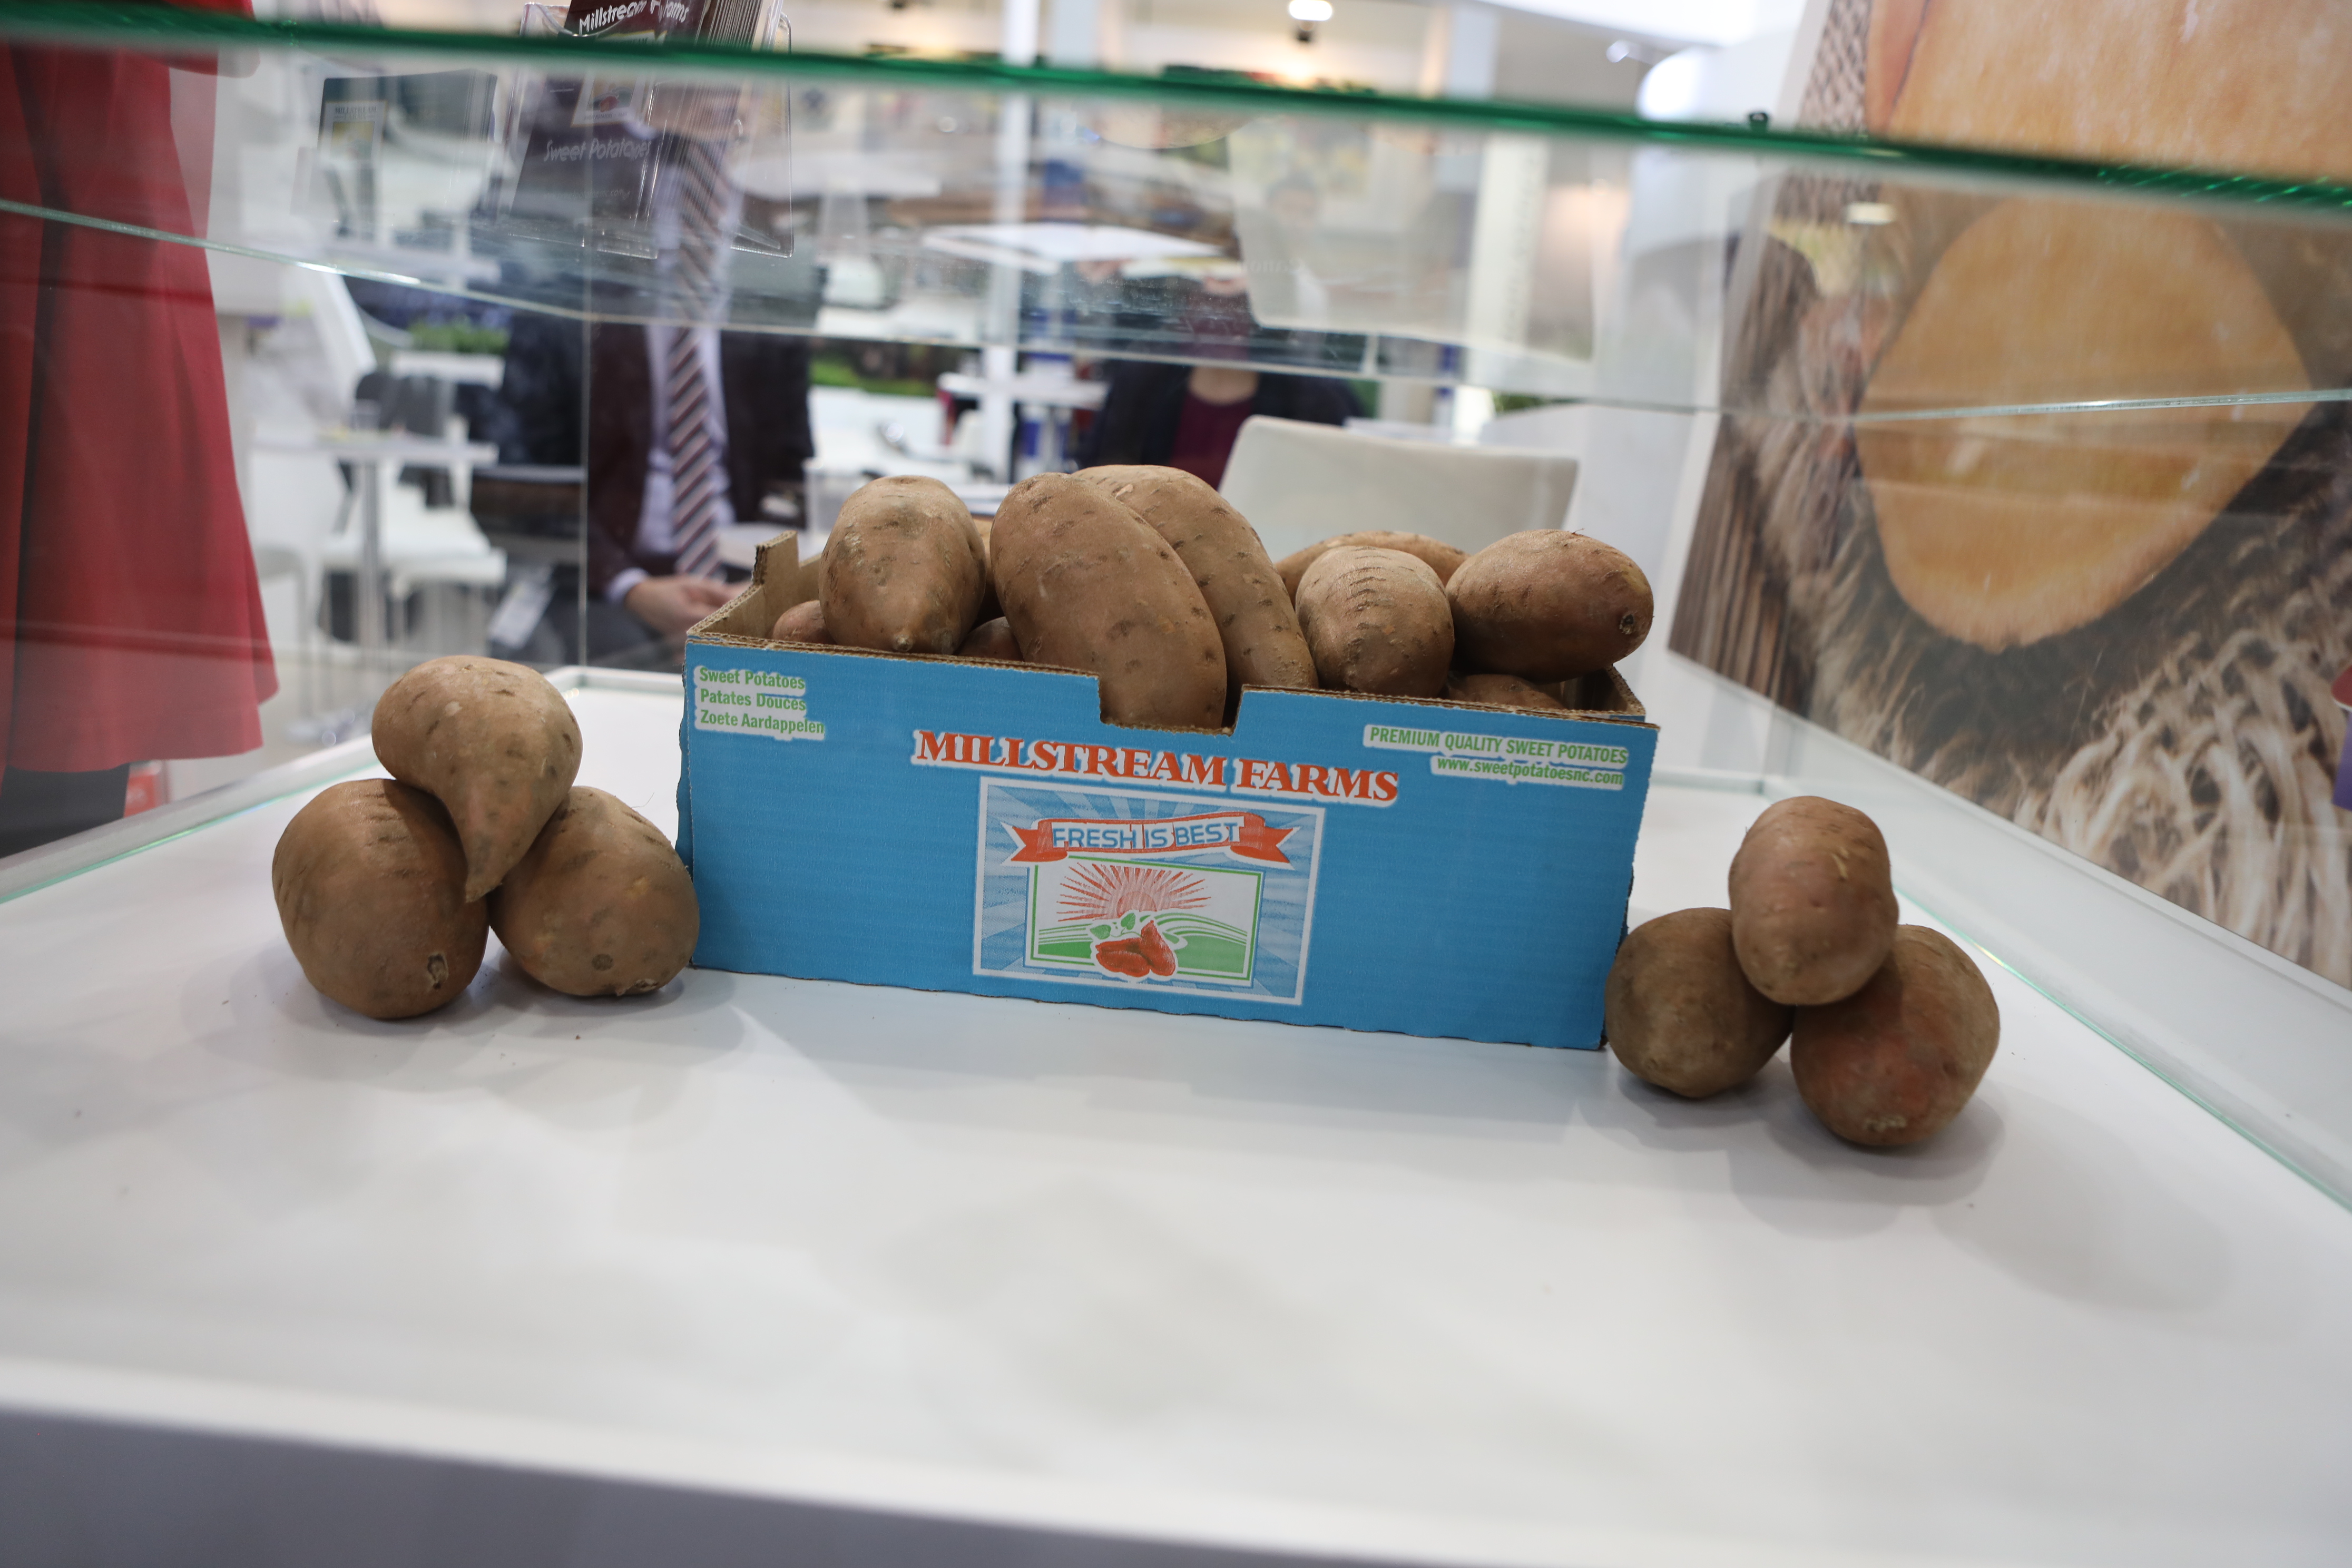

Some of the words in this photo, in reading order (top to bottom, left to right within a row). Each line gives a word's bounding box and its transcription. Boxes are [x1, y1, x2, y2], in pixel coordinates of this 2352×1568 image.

[580, 0, 647, 35] Millstream
[544, 139, 586, 162] Sweet
[700, 668, 740, 684] Sweet
[745, 671, 806, 690] Potatoes
[700, 689, 752, 706] Patates
[757, 693, 806, 711] Douces
[700, 710, 738, 726] Zoete
[741, 713, 825, 734] Aardappelen
[1370, 727, 1440, 747] PREMIUM
[1445, 734, 1503, 753] QUALITY
[1506, 739, 1554, 757] SWEET
[1558, 744, 1628, 763] POTATOES
[916, 730, 1227, 786] MILLSTREAM
[1236, 759, 1398, 801] FARMS
[1437, 758, 1624, 786] www.sweetpotatoesnc.com
[1054, 828, 1137, 849] FRESH
[1145, 828, 1173, 848] IS
[1174, 822, 1238, 847] BEST
